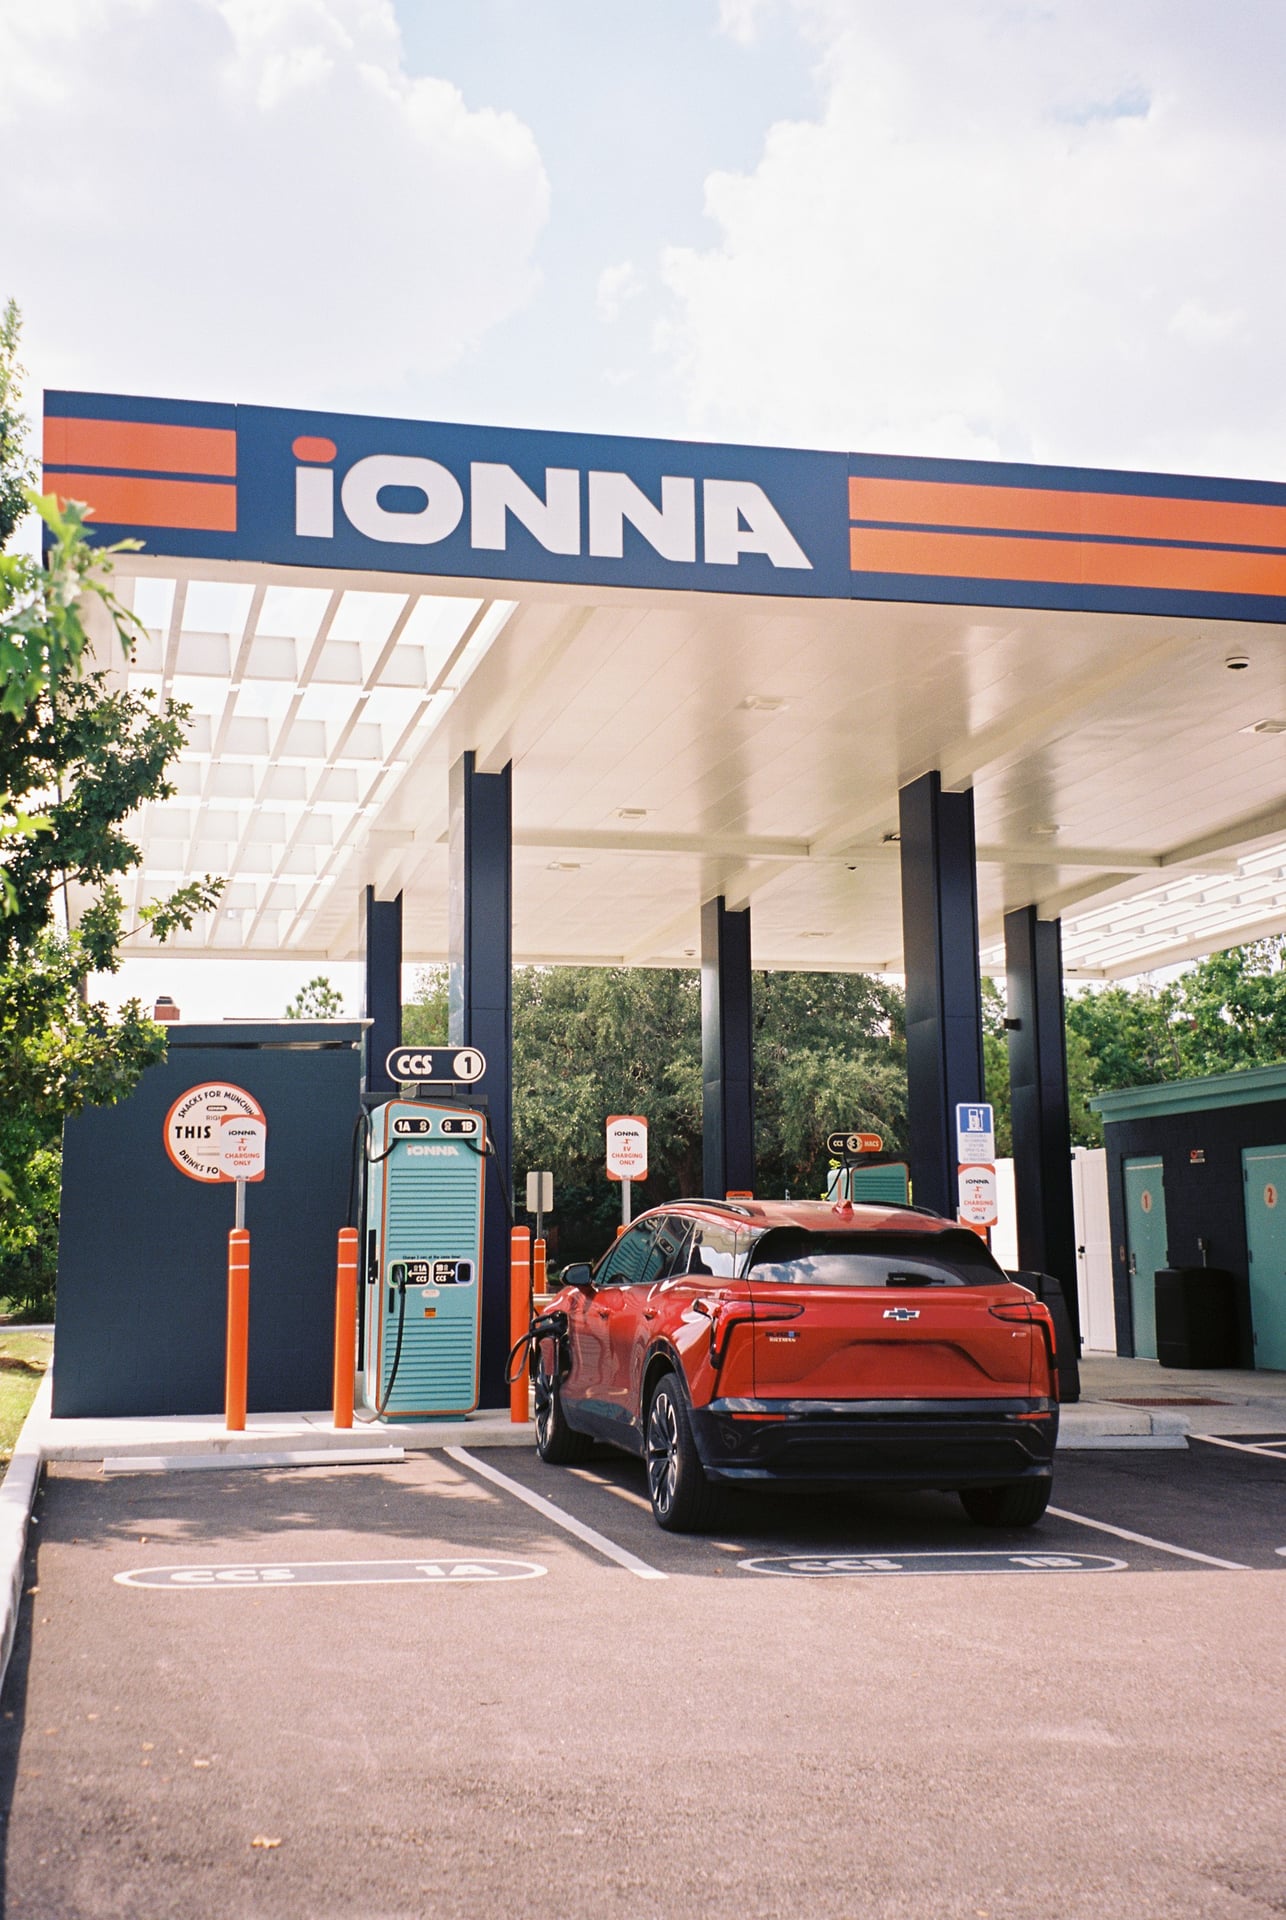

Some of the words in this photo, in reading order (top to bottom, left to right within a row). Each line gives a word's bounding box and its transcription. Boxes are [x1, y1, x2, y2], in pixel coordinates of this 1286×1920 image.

[397, 1054, 433, 1075] CCS
[464, 1057, 472, 1074] 1
[178, 1093, 203, 1119] SNACKS
[204, 1090, 221, 1099] FOR
[223, 1091, 255, 1115] MUNCHIN
[175, 1125, 212, 1139] THIS
[397, 1121, 411, 1132] 1A
[461, 1121, 473, 1132] 1B
[851, 1137, 858, 1149] 3
[179, 1149, 205, 1172] DRINKS
[206, 1166, 219, 1174] FO
[1144, 1195, 1149, 1209] 1
[1267, 1188, 1274, 1204] 2
[788, 1559, 903, 1572] CCS
[170, 1568, 295, 1583] CCS
[415, 1564, 499, 1577] 1A
